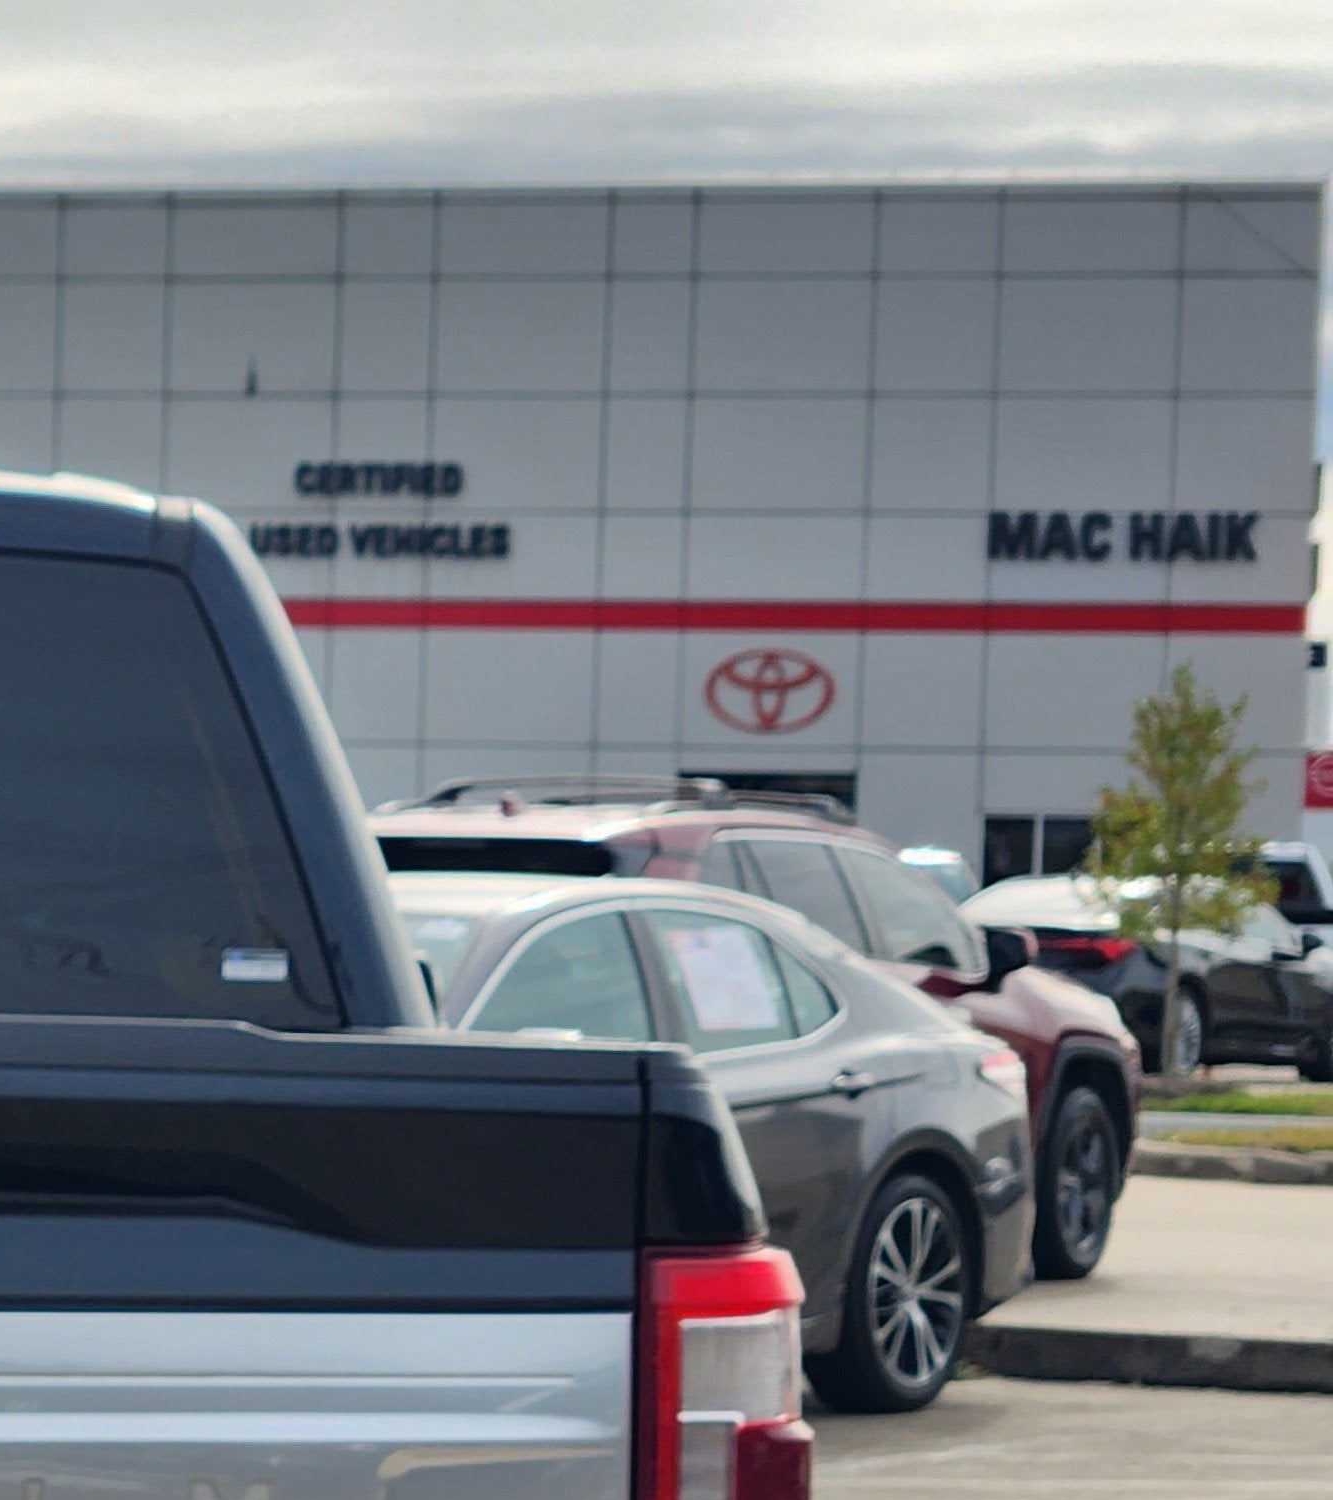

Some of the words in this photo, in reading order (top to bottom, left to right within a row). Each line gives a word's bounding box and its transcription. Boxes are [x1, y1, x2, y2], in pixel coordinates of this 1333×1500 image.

[295, 461, 463, 495] CERTIFIED
[250, 523, 338, 556] USED
[350, 523, 510, 557] VEHICLES
[987, 510, 1112, 562] MAC
[1129, 510, 1260, 562] HAIK
